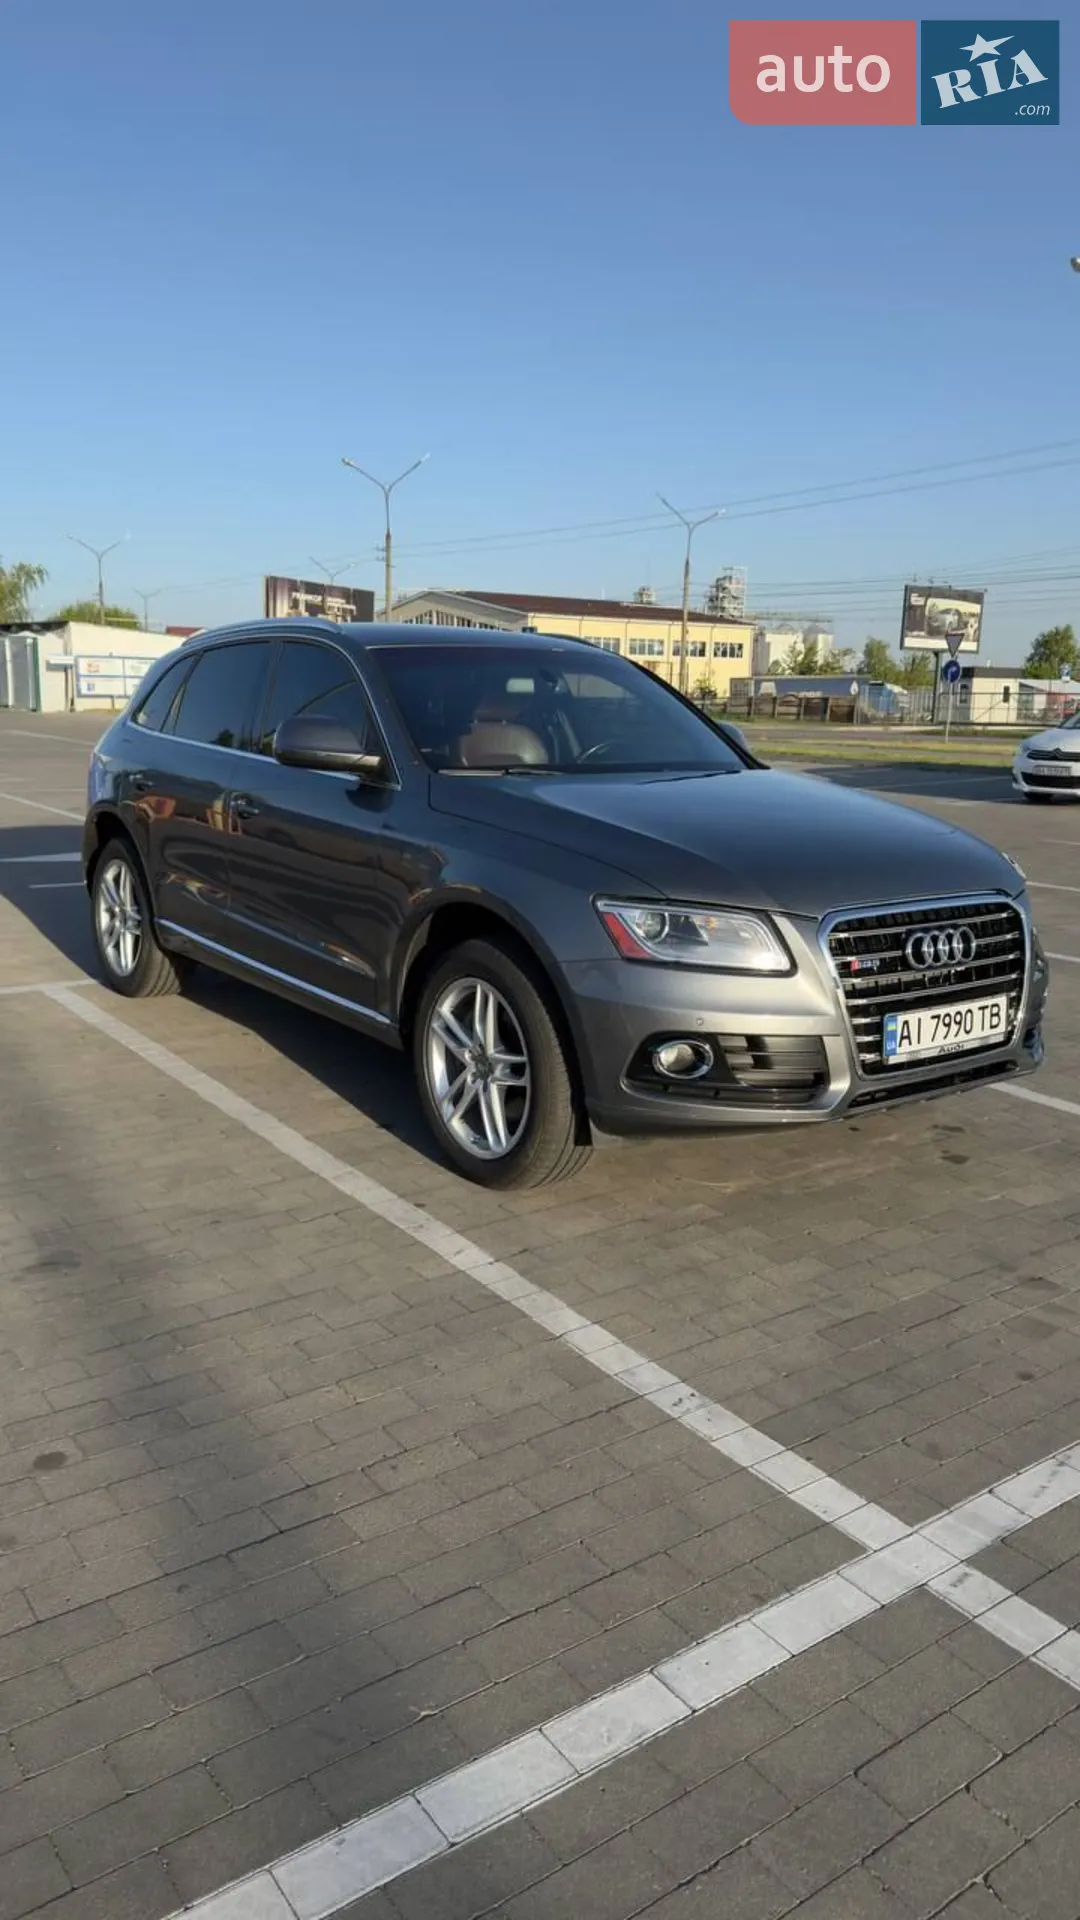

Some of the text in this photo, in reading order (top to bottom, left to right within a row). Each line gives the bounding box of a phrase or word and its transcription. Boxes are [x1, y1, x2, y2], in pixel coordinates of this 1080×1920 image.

[898, 1003, 1001, 1048] AI 7990 TB
[937, 1043, 965, 1054] Audi
